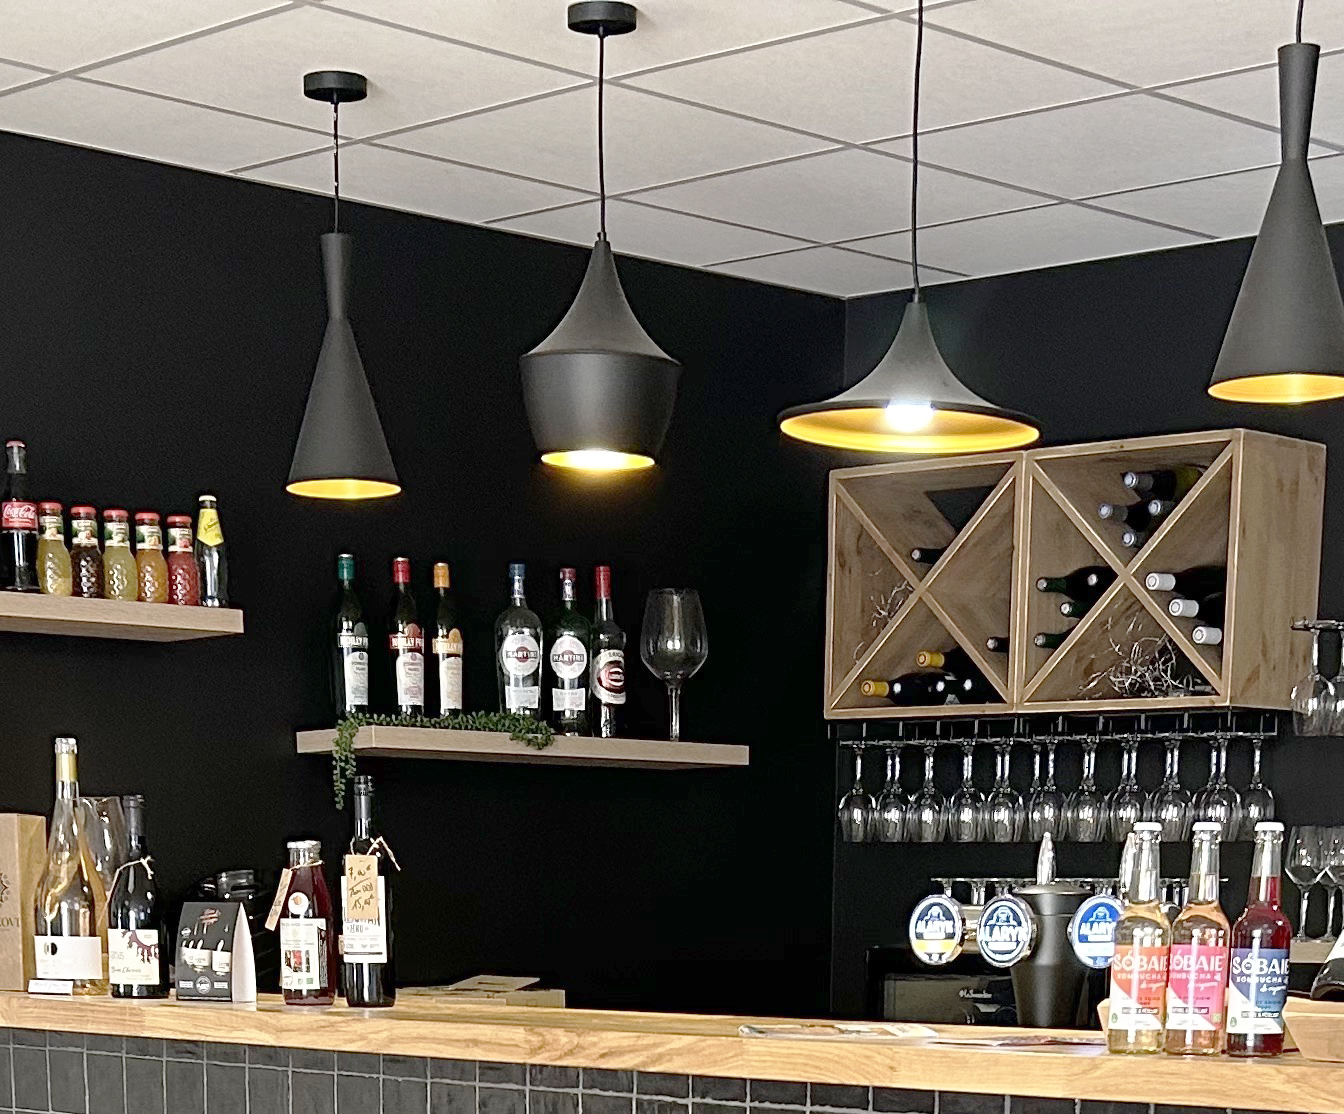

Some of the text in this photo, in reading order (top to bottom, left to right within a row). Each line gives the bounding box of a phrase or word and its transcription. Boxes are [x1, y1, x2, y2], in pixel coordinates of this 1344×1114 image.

[507, 651, 537, 659] MARTINI
[553, 653, 585, 663] MARTINI
[1079, 921, 1117, 937] ALARY
